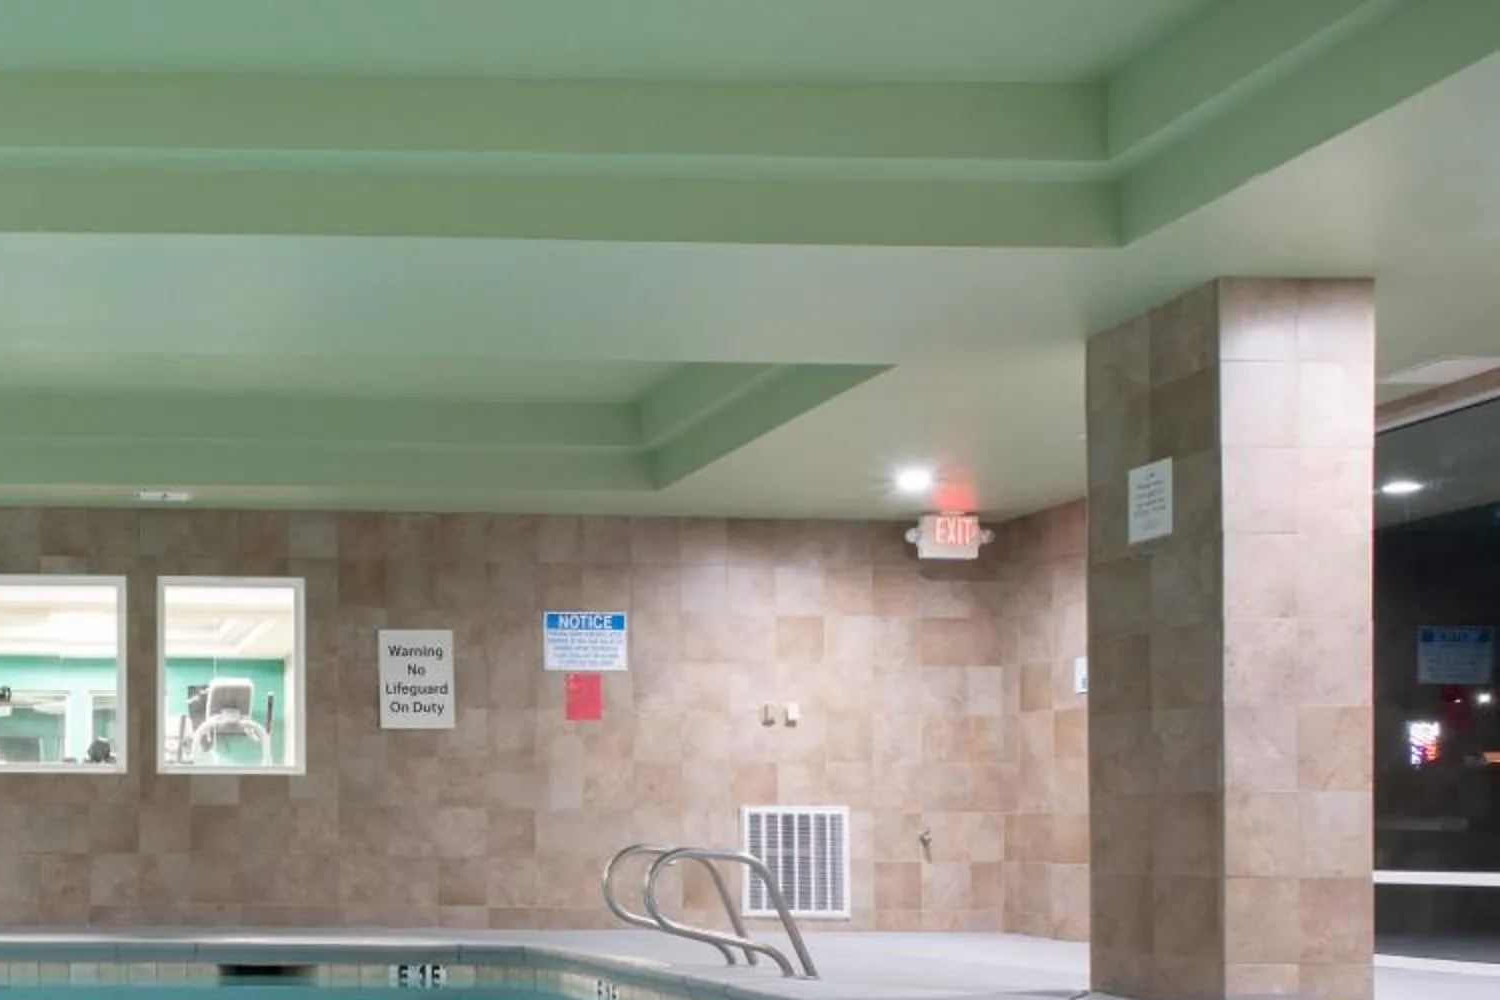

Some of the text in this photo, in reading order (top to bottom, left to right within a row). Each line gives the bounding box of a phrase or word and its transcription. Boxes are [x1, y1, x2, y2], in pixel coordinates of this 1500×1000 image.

[935, 516, 974, 545] EXIT
[558, 614, 613, 630] NOTICE
[387, 645, 443, 661] Warning
[407, 663, 426, 676] No
[385, 681, 448, 697] Lifeguard
[390, 701, 445, 716] On Duty
